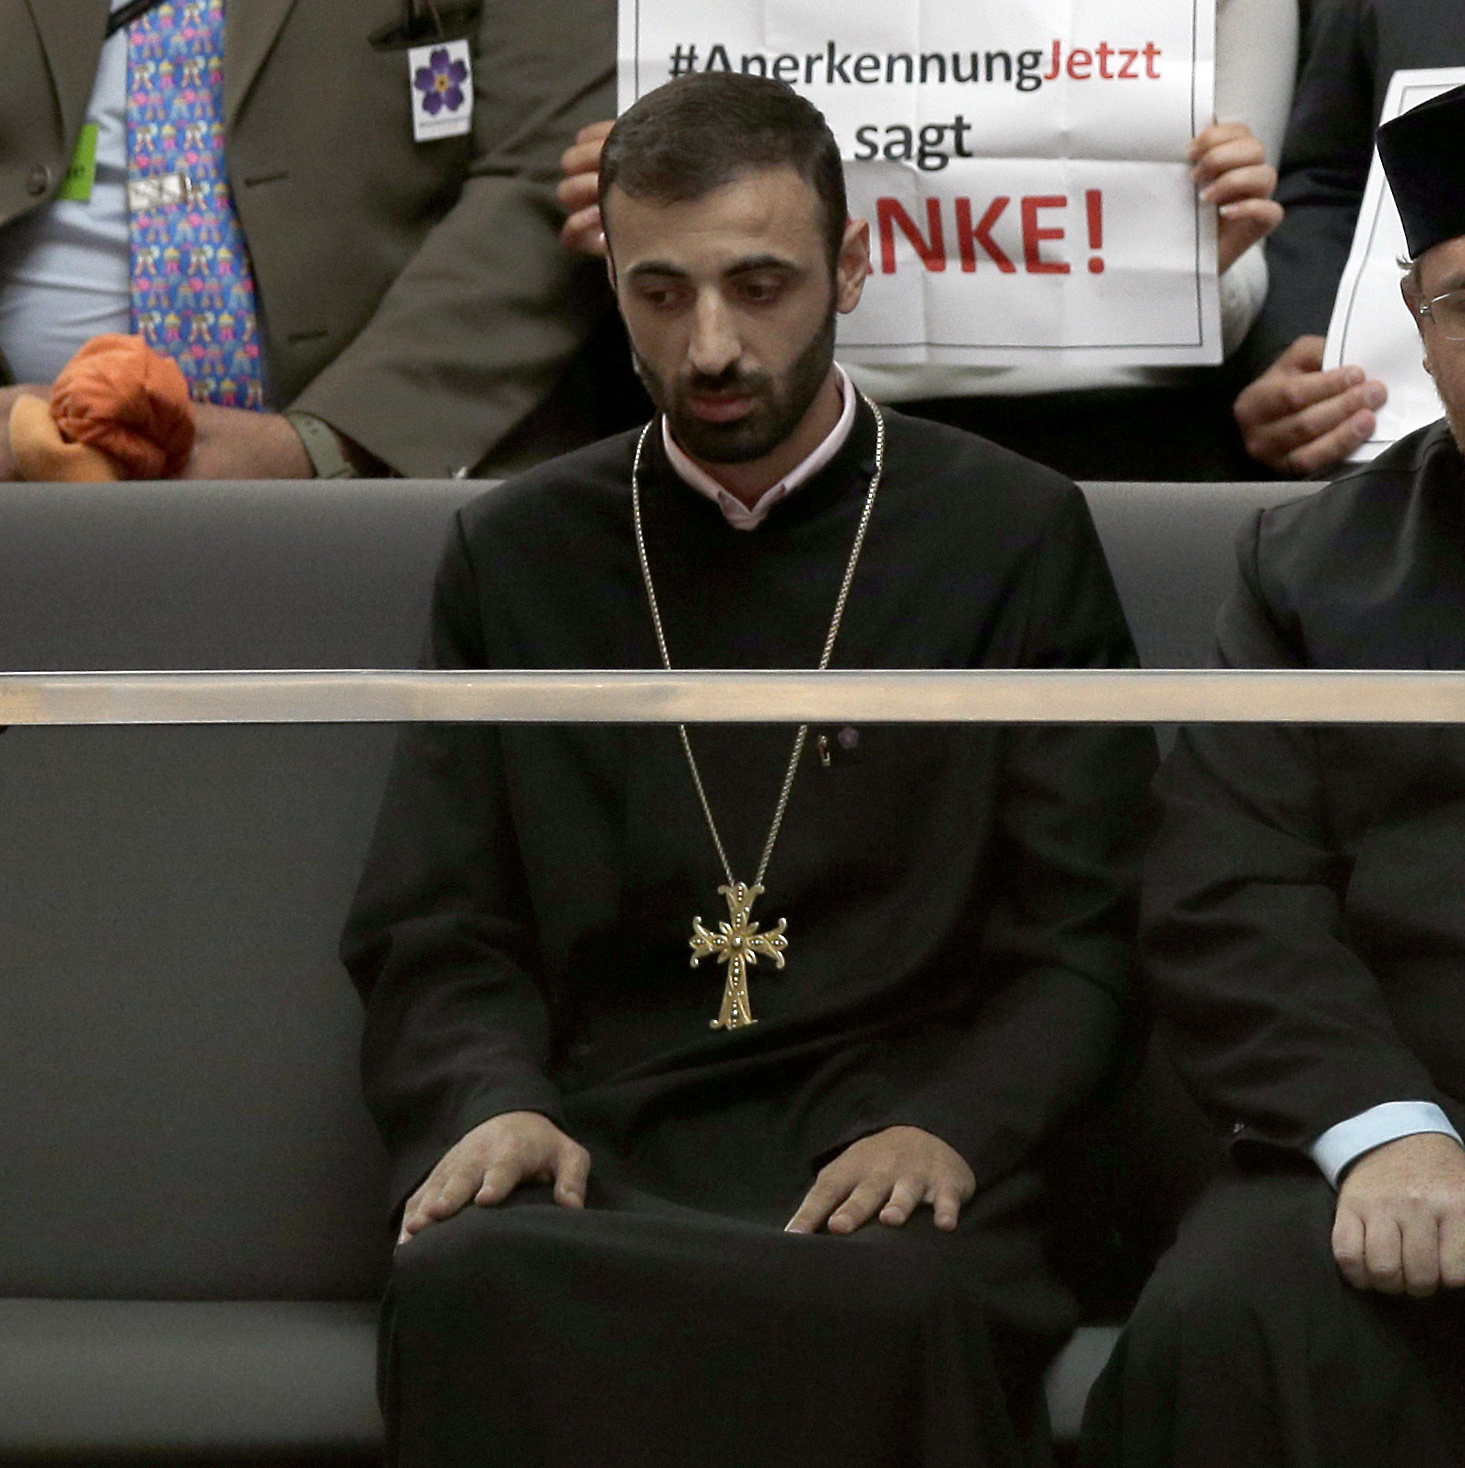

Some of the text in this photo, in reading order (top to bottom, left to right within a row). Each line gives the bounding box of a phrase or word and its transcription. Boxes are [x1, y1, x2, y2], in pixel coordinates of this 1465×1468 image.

[669, 39, 1161, 90] #AnerkennungJetzt
[854, 114, 973, 171] sagt
[876, 189, 1103, 275] NKE!
